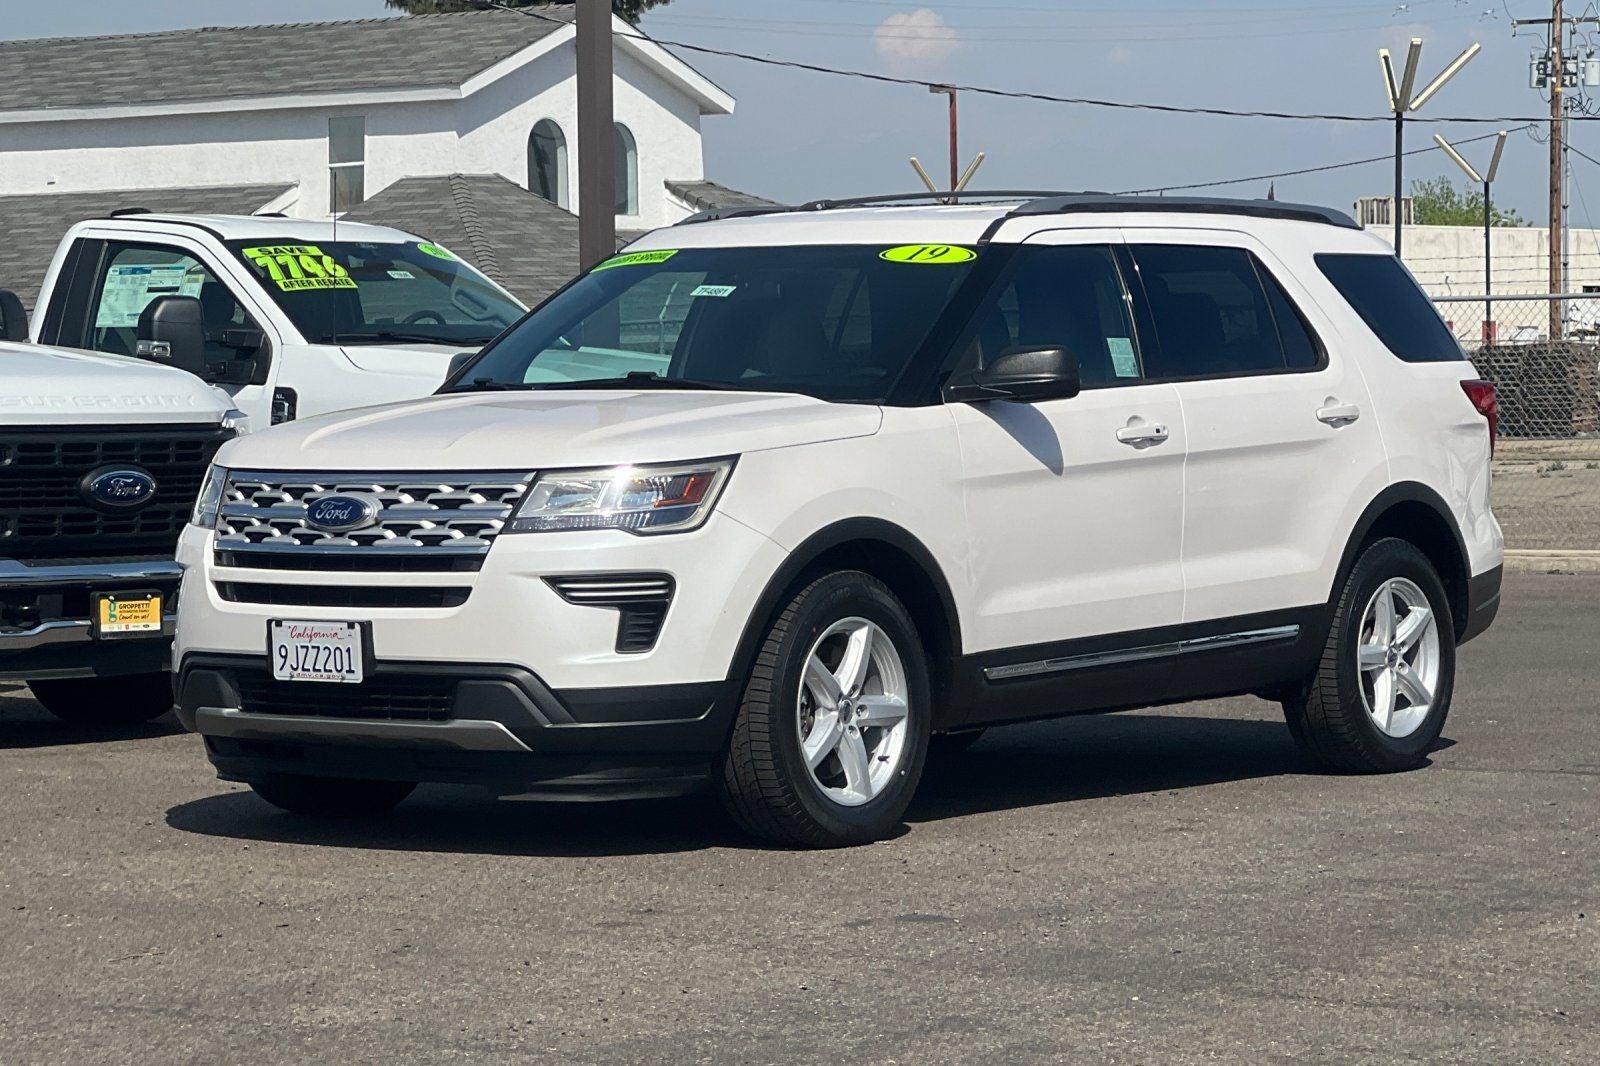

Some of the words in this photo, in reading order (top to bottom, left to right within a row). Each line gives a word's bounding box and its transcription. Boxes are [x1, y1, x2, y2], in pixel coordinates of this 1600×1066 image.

[257, 246, 310, 255] SAVE
[904, 246, 951, 261] 19
[282, 280, 316, 289] AFTER
[316, 279, 355, 288] REBATE
[107, 477, 142, 497] Ford
[315, 500, 353, 520] Ford
[289, 625, 340, 643] California
[278, 644, 356, 674] 9JZZ201
